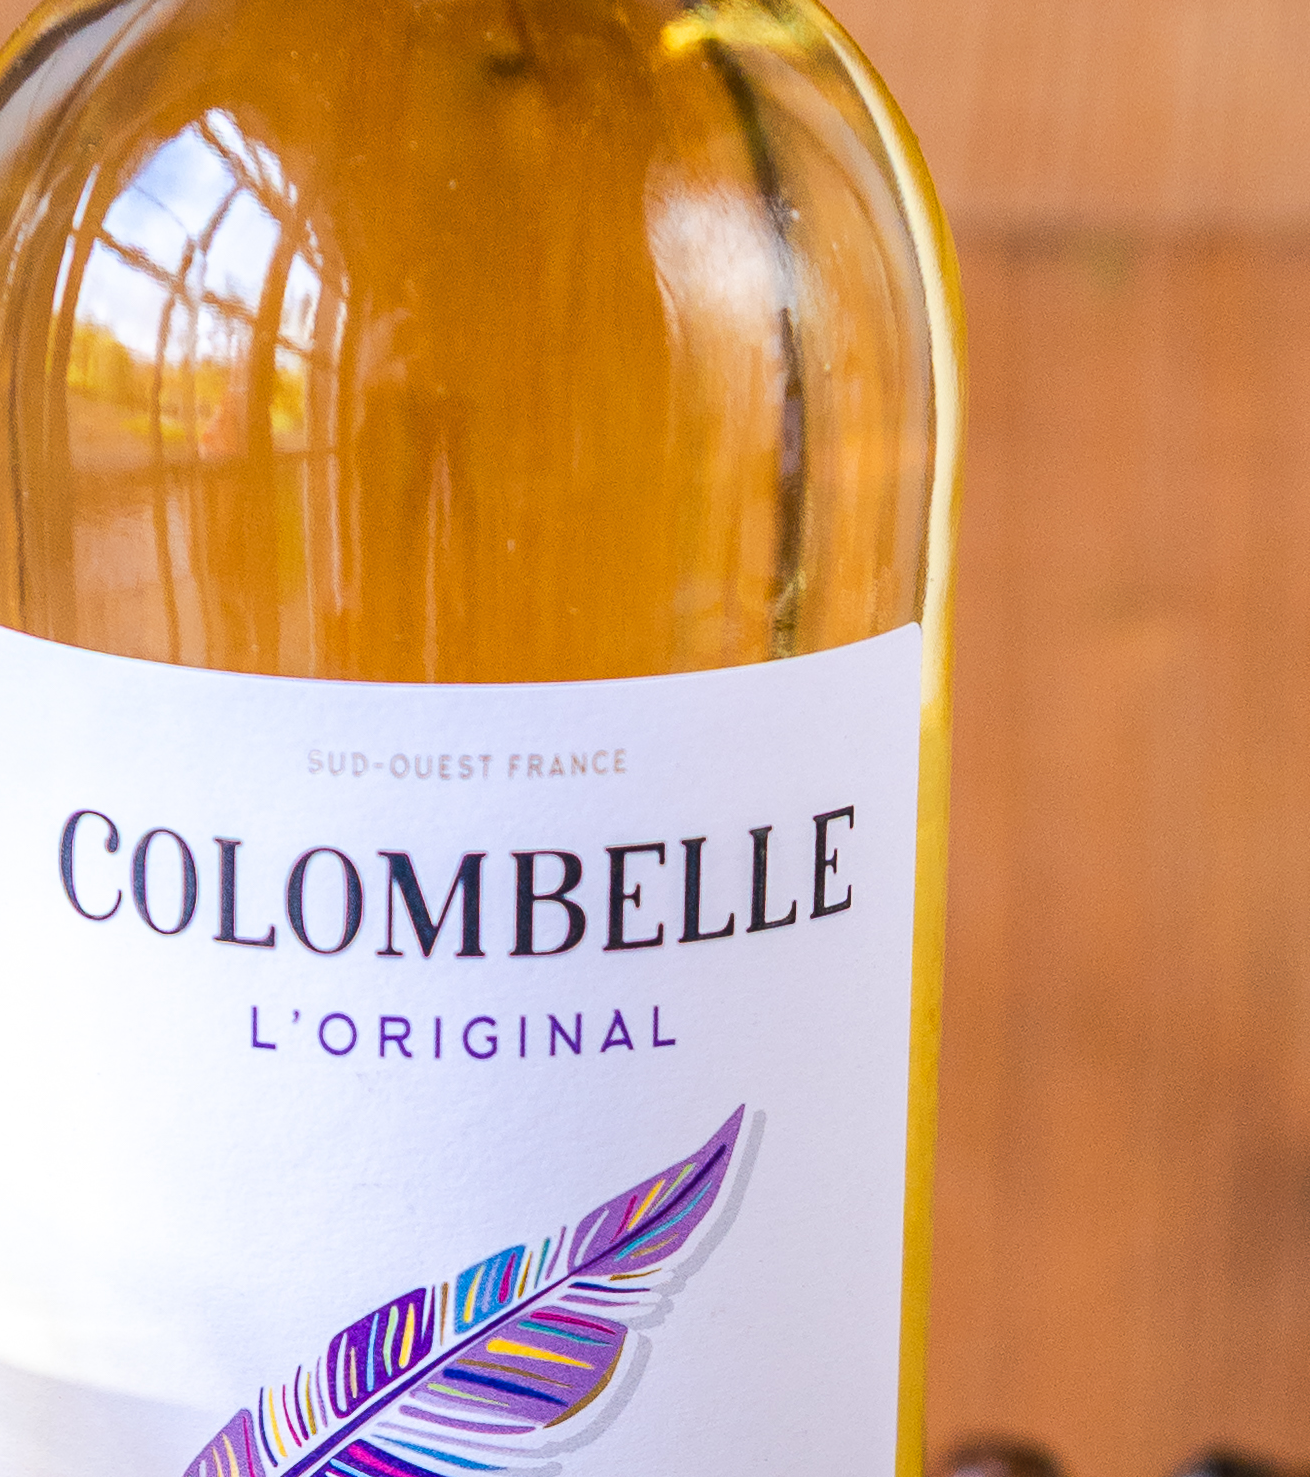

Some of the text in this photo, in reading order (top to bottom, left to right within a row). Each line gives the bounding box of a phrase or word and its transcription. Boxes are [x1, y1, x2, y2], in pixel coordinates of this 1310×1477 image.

[307, 748, 627, 780] SUD-OUEST FRANCE
[59, 805, 855, 959] COLOMBELLE
[251, 1005, 677, 1060] L'ORIGINAL
